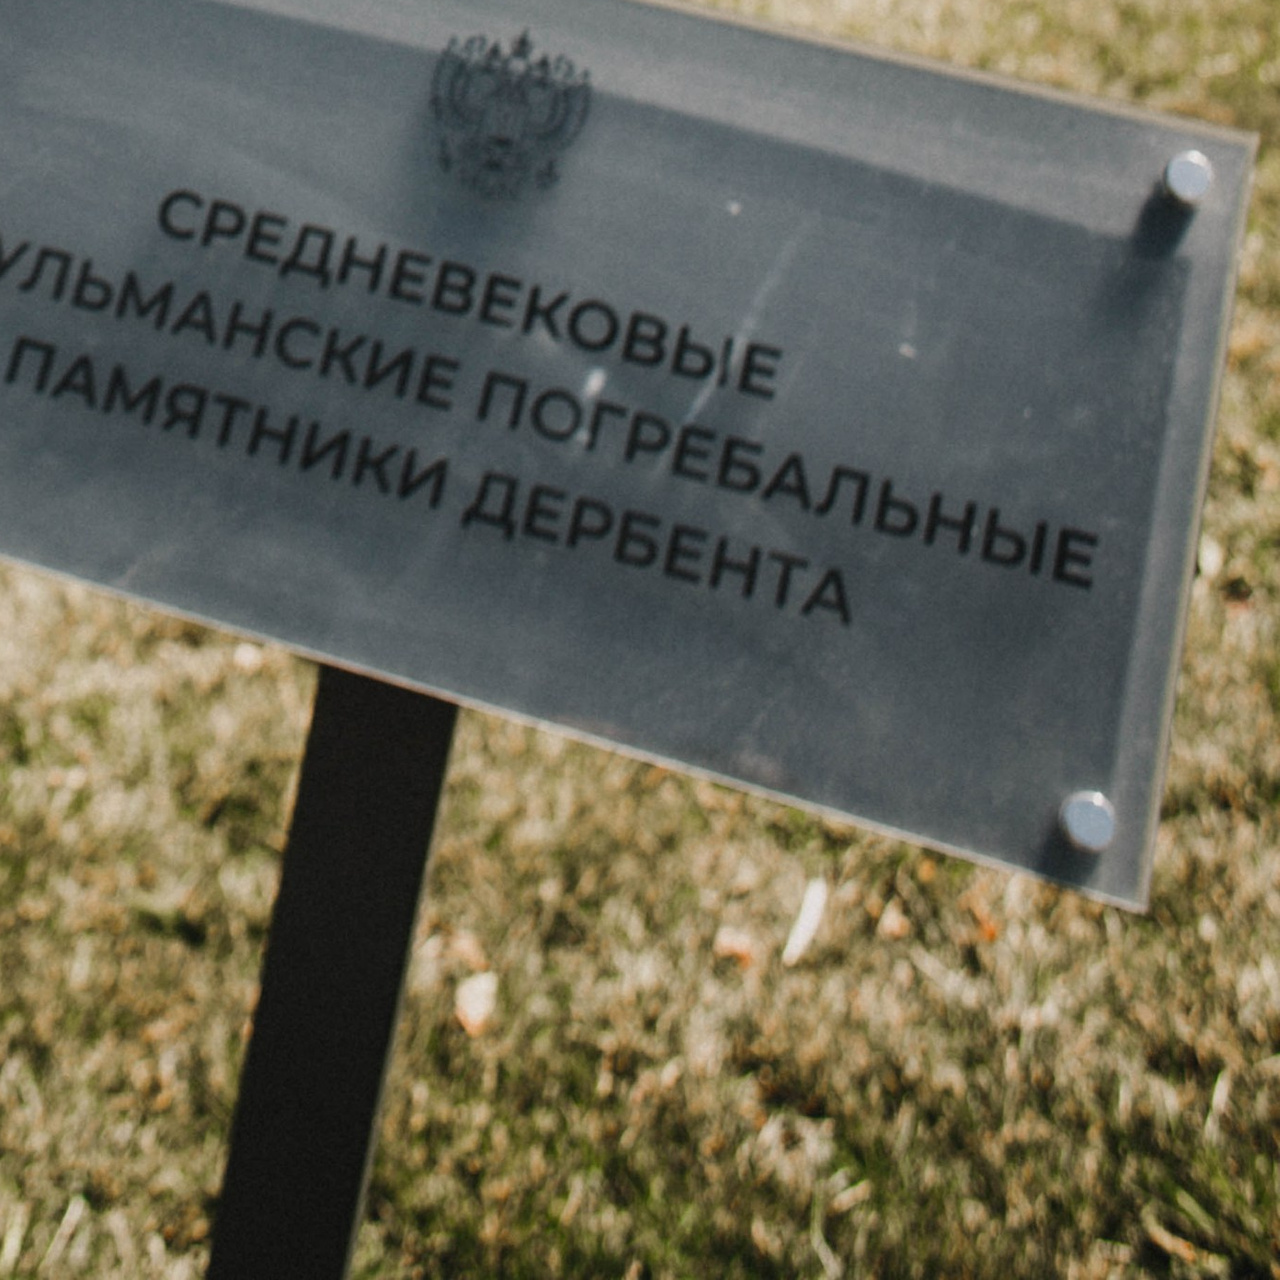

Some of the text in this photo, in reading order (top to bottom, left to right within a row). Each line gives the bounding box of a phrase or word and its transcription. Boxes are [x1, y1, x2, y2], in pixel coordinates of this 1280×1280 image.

[156, 189, 781, 399] СРЕДНЕВЕКОВЫЕ
[4, 338, 853, 624] ПАМЯТНИКИ ДЕРБЕНТА
[478, 371, 1099, 590] ПОГРЕБАЛЬНЫЕ
